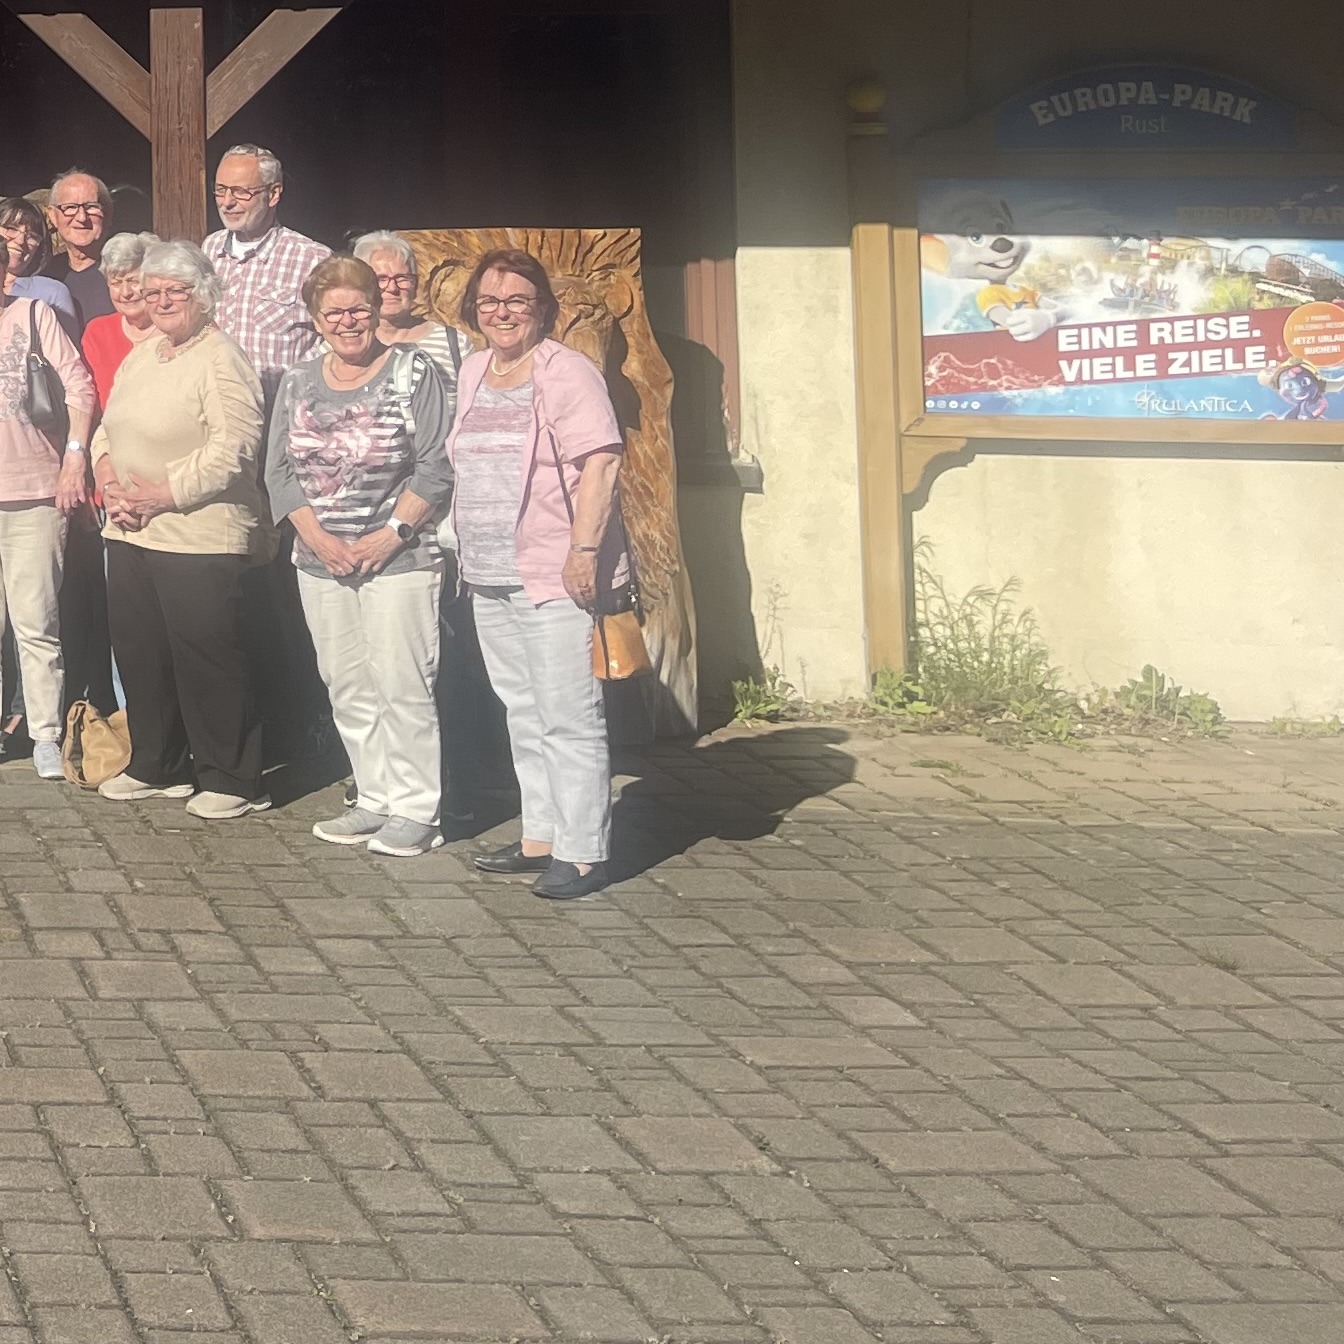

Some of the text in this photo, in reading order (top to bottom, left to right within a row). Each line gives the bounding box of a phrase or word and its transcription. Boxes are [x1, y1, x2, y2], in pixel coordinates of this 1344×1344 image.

[1029, 81, 1258, 127] EUROPA-PARK
[1121, 114, 1168, 134] Rust
[1058, 316, 1261, 352] EINE REISE.
[1058, 345, 1277, 382] VIELE ZIELE.
[1150, 396, 1254, 415] RULANTICA
